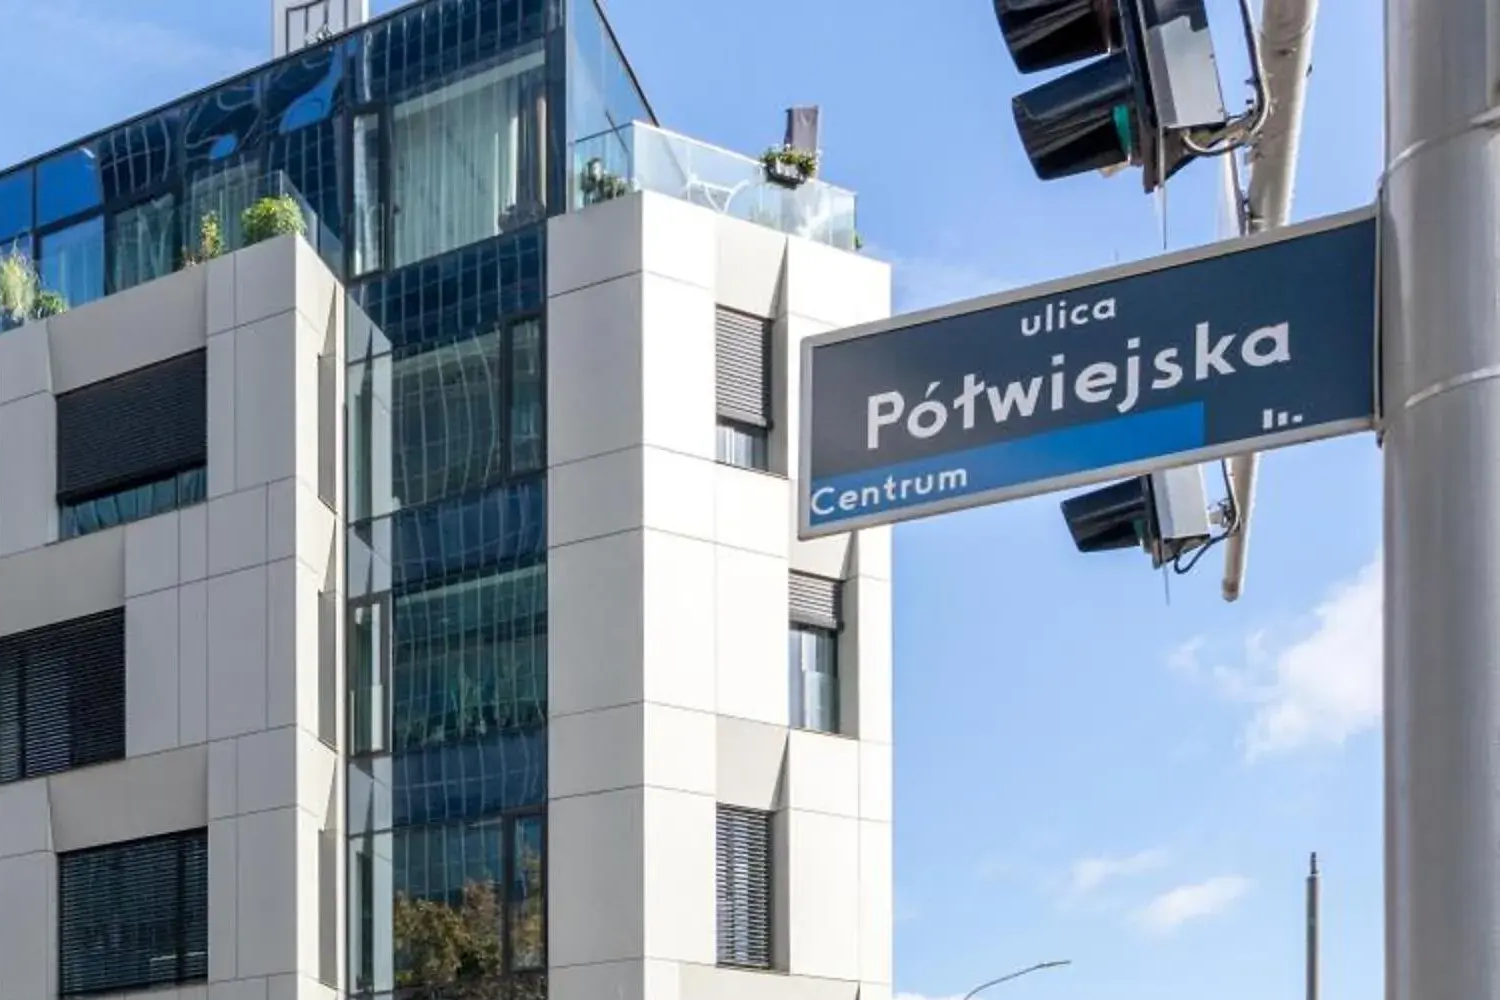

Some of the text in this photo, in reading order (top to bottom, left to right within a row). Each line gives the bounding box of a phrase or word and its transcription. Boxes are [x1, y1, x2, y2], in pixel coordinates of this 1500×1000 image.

[1020, 297, 1118, 337] ulica
[866, 320, 1292, 450] Półwiejska
[810, 467, 968, 517] Centrum
